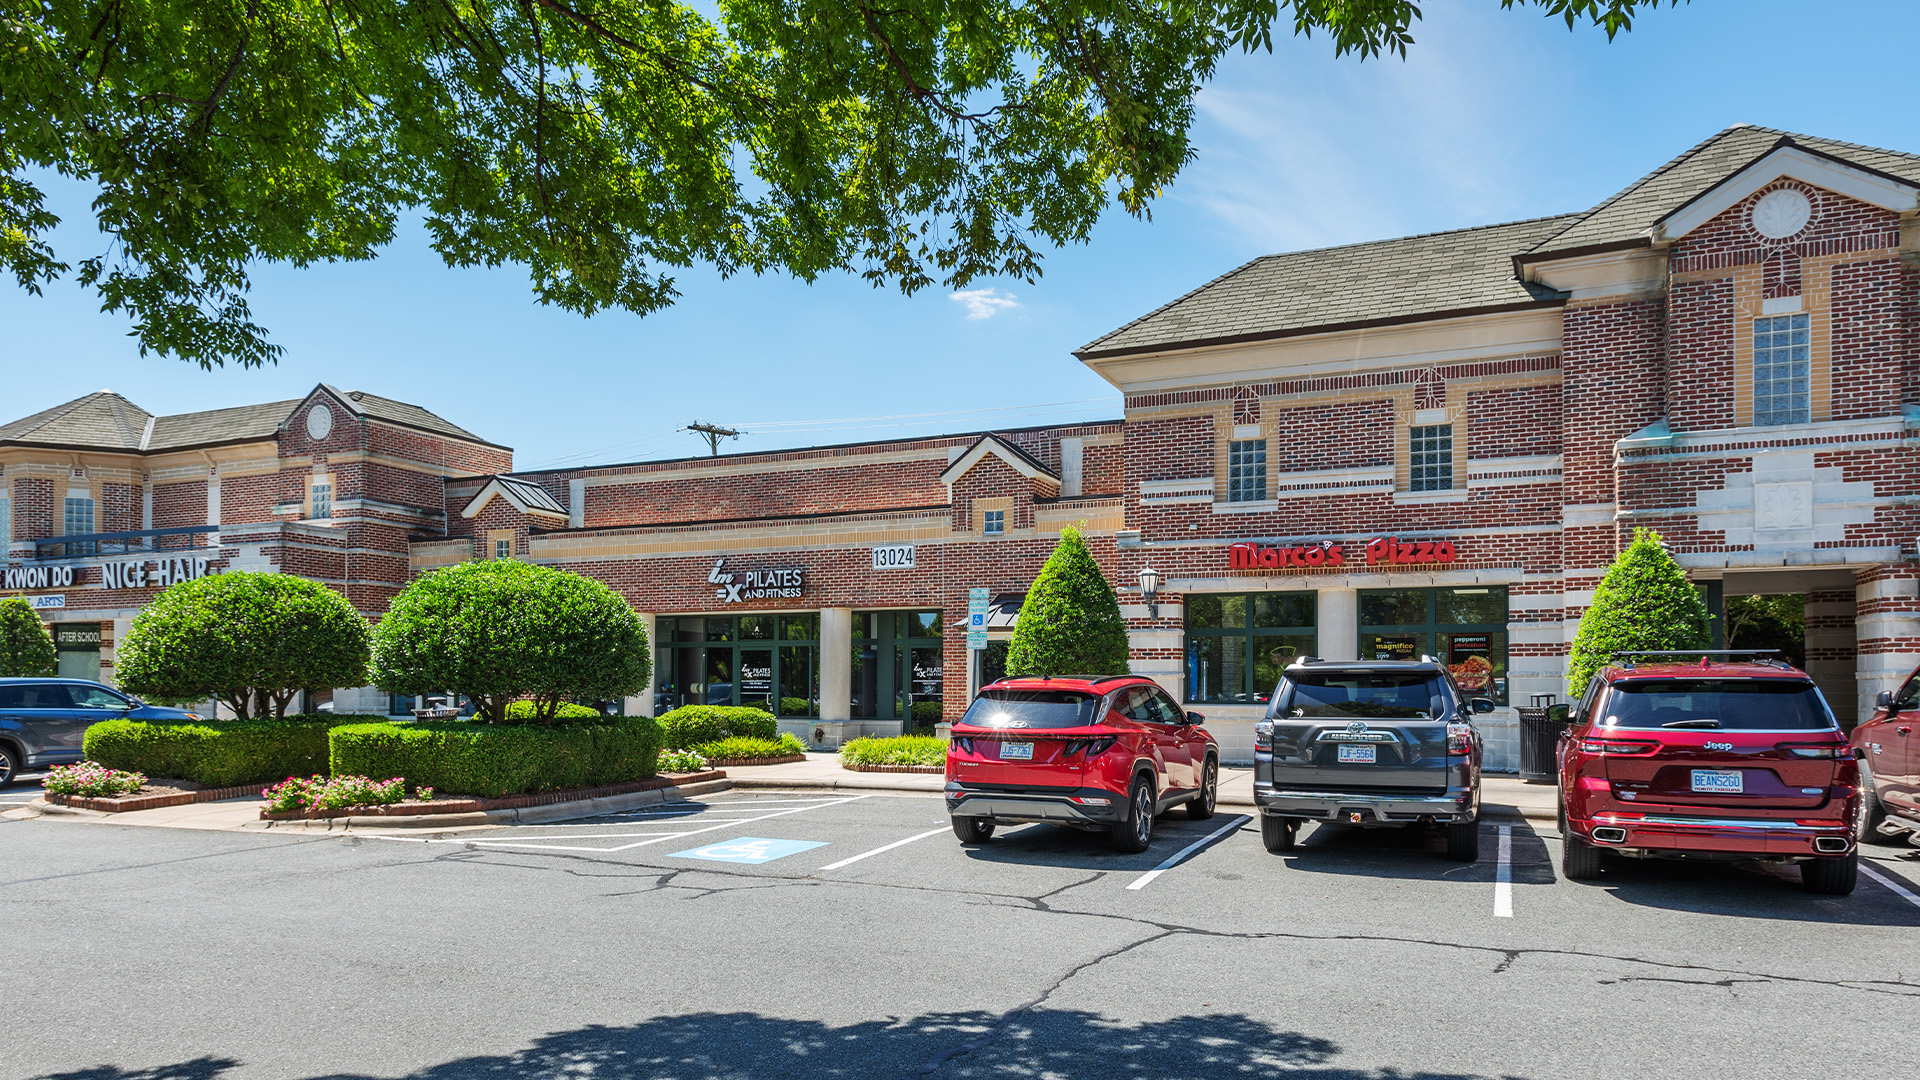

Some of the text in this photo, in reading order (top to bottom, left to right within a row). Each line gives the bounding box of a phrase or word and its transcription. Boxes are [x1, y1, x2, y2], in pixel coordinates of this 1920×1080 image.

[874, 547, 913, 566] 13024
[1229, 536, 1456, 569] Marco's Pizza
[5, 565, 73, 589] KWON DO
[101, 556, 208, 590] NICE HAIR
[745, 569, 802, 588] PILATES
[744, 587, 802, 600] AND FITNESS
[36, 596, 64, 607] ARTS
[57, 631, 101, 642] AFTER SCHOOL
[1703, 740, 1733, 751] Jeep
[1340, 748, 1374, 759] TJF-5564
[1694, 774, 1740, 787] BEANS2GO
